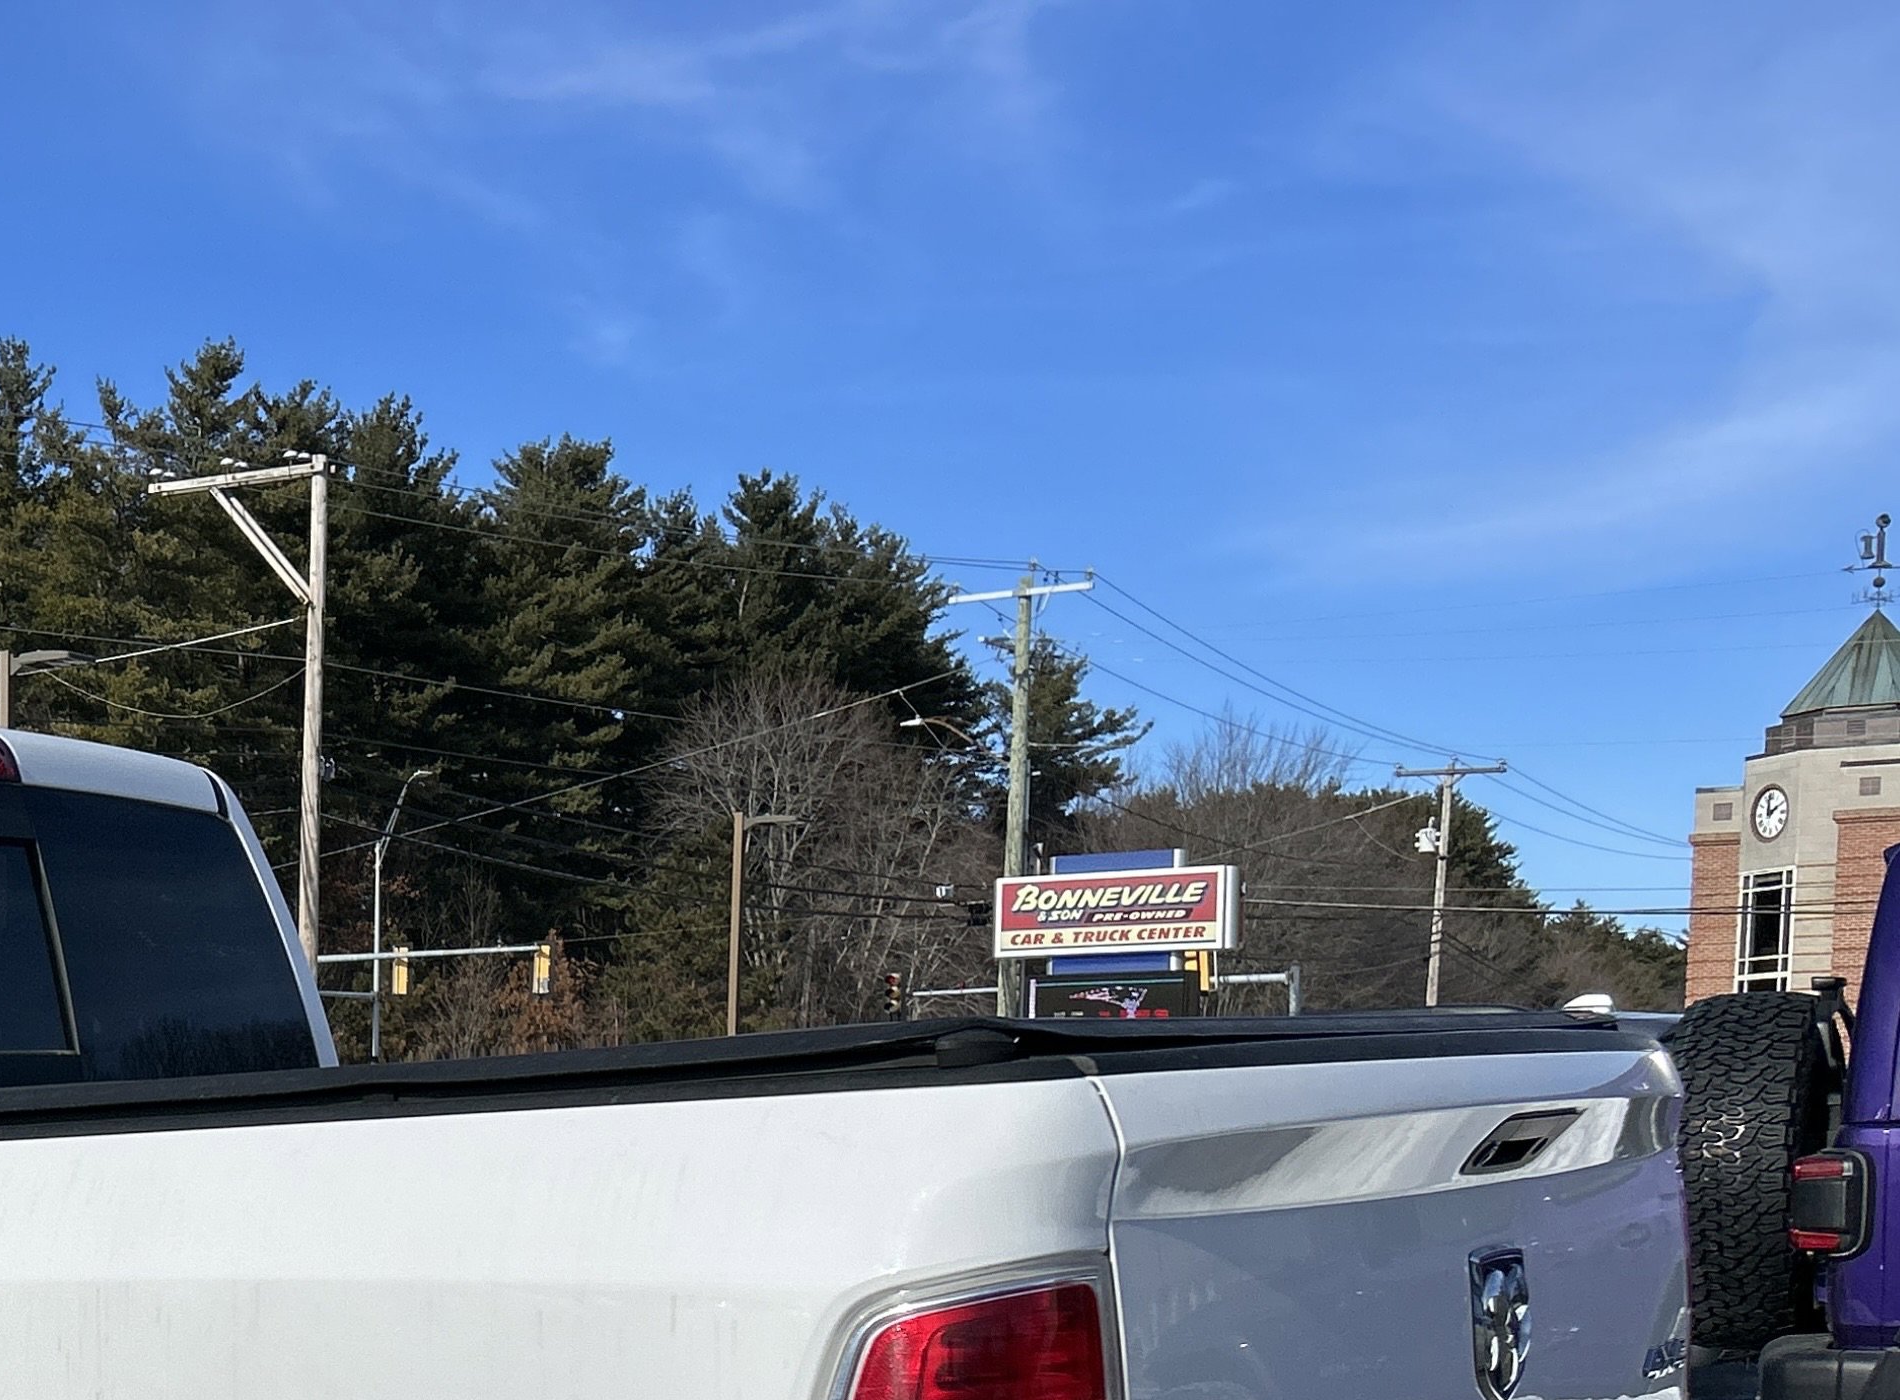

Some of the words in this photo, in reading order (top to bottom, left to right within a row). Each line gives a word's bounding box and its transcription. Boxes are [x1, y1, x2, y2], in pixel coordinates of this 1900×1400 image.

[1012, 880, 1208, 912] BONNEVILLE
[1092, 910, 1186, 923] PRE-OWNED
[1010, 933, 1045, 947] CAR
[1051, 931, 1064, 945] &
[1072, 928, 1131, 944] TRUCK
[1136, 925, 1207, 941] CENTER
